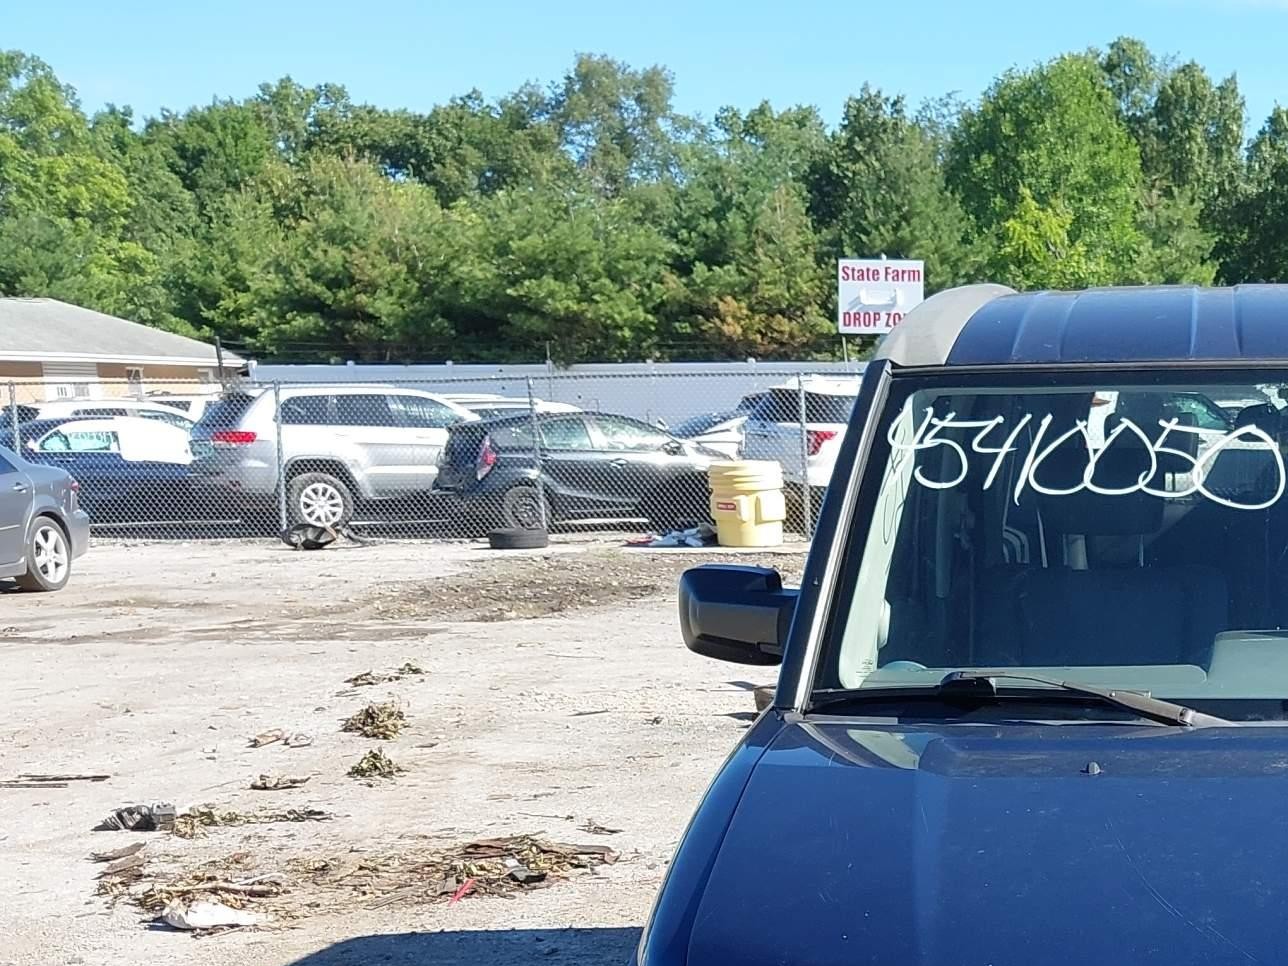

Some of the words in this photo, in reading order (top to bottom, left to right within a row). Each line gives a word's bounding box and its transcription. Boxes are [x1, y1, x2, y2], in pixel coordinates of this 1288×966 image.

[841, 265, 880, 282] State
[884, 266, 921, 283] Farm
[842, 311, 881, 328] DROP
[885, 312, 906, 328] ZO
[887, 406, 1286, 510] 45410050
